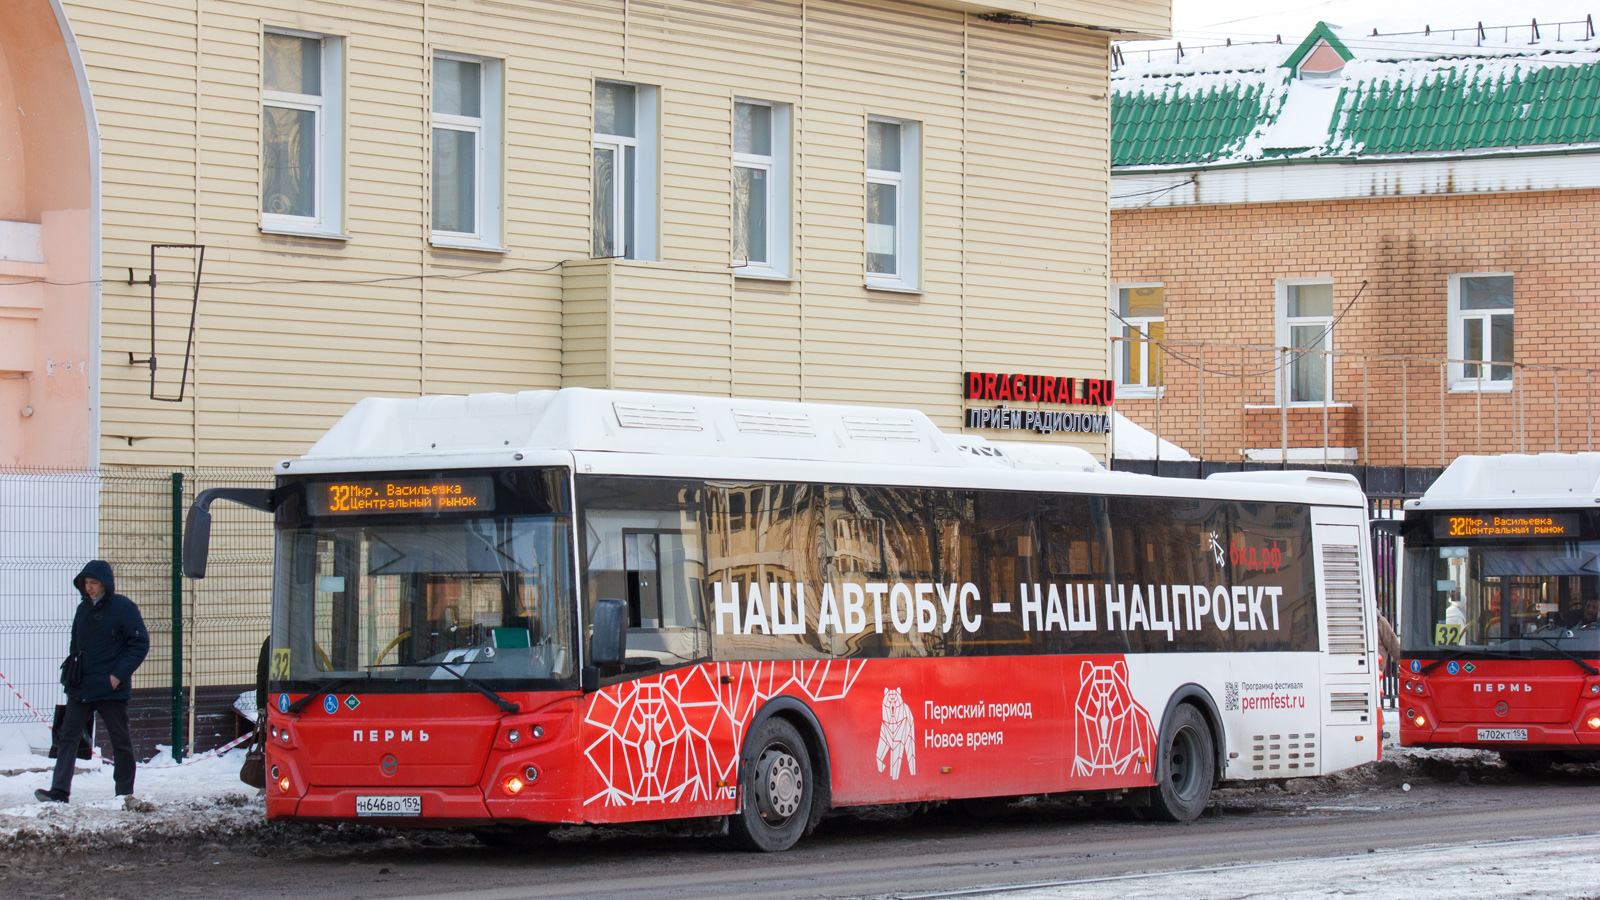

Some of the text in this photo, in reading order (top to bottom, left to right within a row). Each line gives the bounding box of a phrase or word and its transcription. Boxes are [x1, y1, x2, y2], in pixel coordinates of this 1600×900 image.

[967, 371, 1115, 406] DRAGURAL.RU
[970, 404, 1111, 434] ПРИЁМ РАДИОЛОМА
[329, 485, 350, 511] 32
[350, 483, 462, 497] Мкр. Васильевка
[350, 496, 477, 510] Центральный рынок
[1449, 517, 1465, 536] 32
[1465, 516, 1553, 527] Мкр. Васильевка
[1465, 525, 1564, 535] Центральный рынок
[1229, 539, 1282, 573] бкд.рф
[713, 581, 807, 635] НАШ
[817, 581, 982, 634] АВТОБУС
[1020, 582, 1098, 632] НАШ
[1105, 583, 1283, 641] НАЦПРОЕКТ
[1437, 626, 1460, 646] 32
[272, 652, 289, 680] 32
[1241, 680, 1304, 691] Программа фестиваля
[1473, 683, 1533, 693] ПЕРМЬ
[924, 700, 1033, 724] Пермский период
[1242, 692, 1305, 714] permfest.ru
[353, 729, 430, 742] ПЕРМЬ
[924, 729, 1004, 751] Новое время
